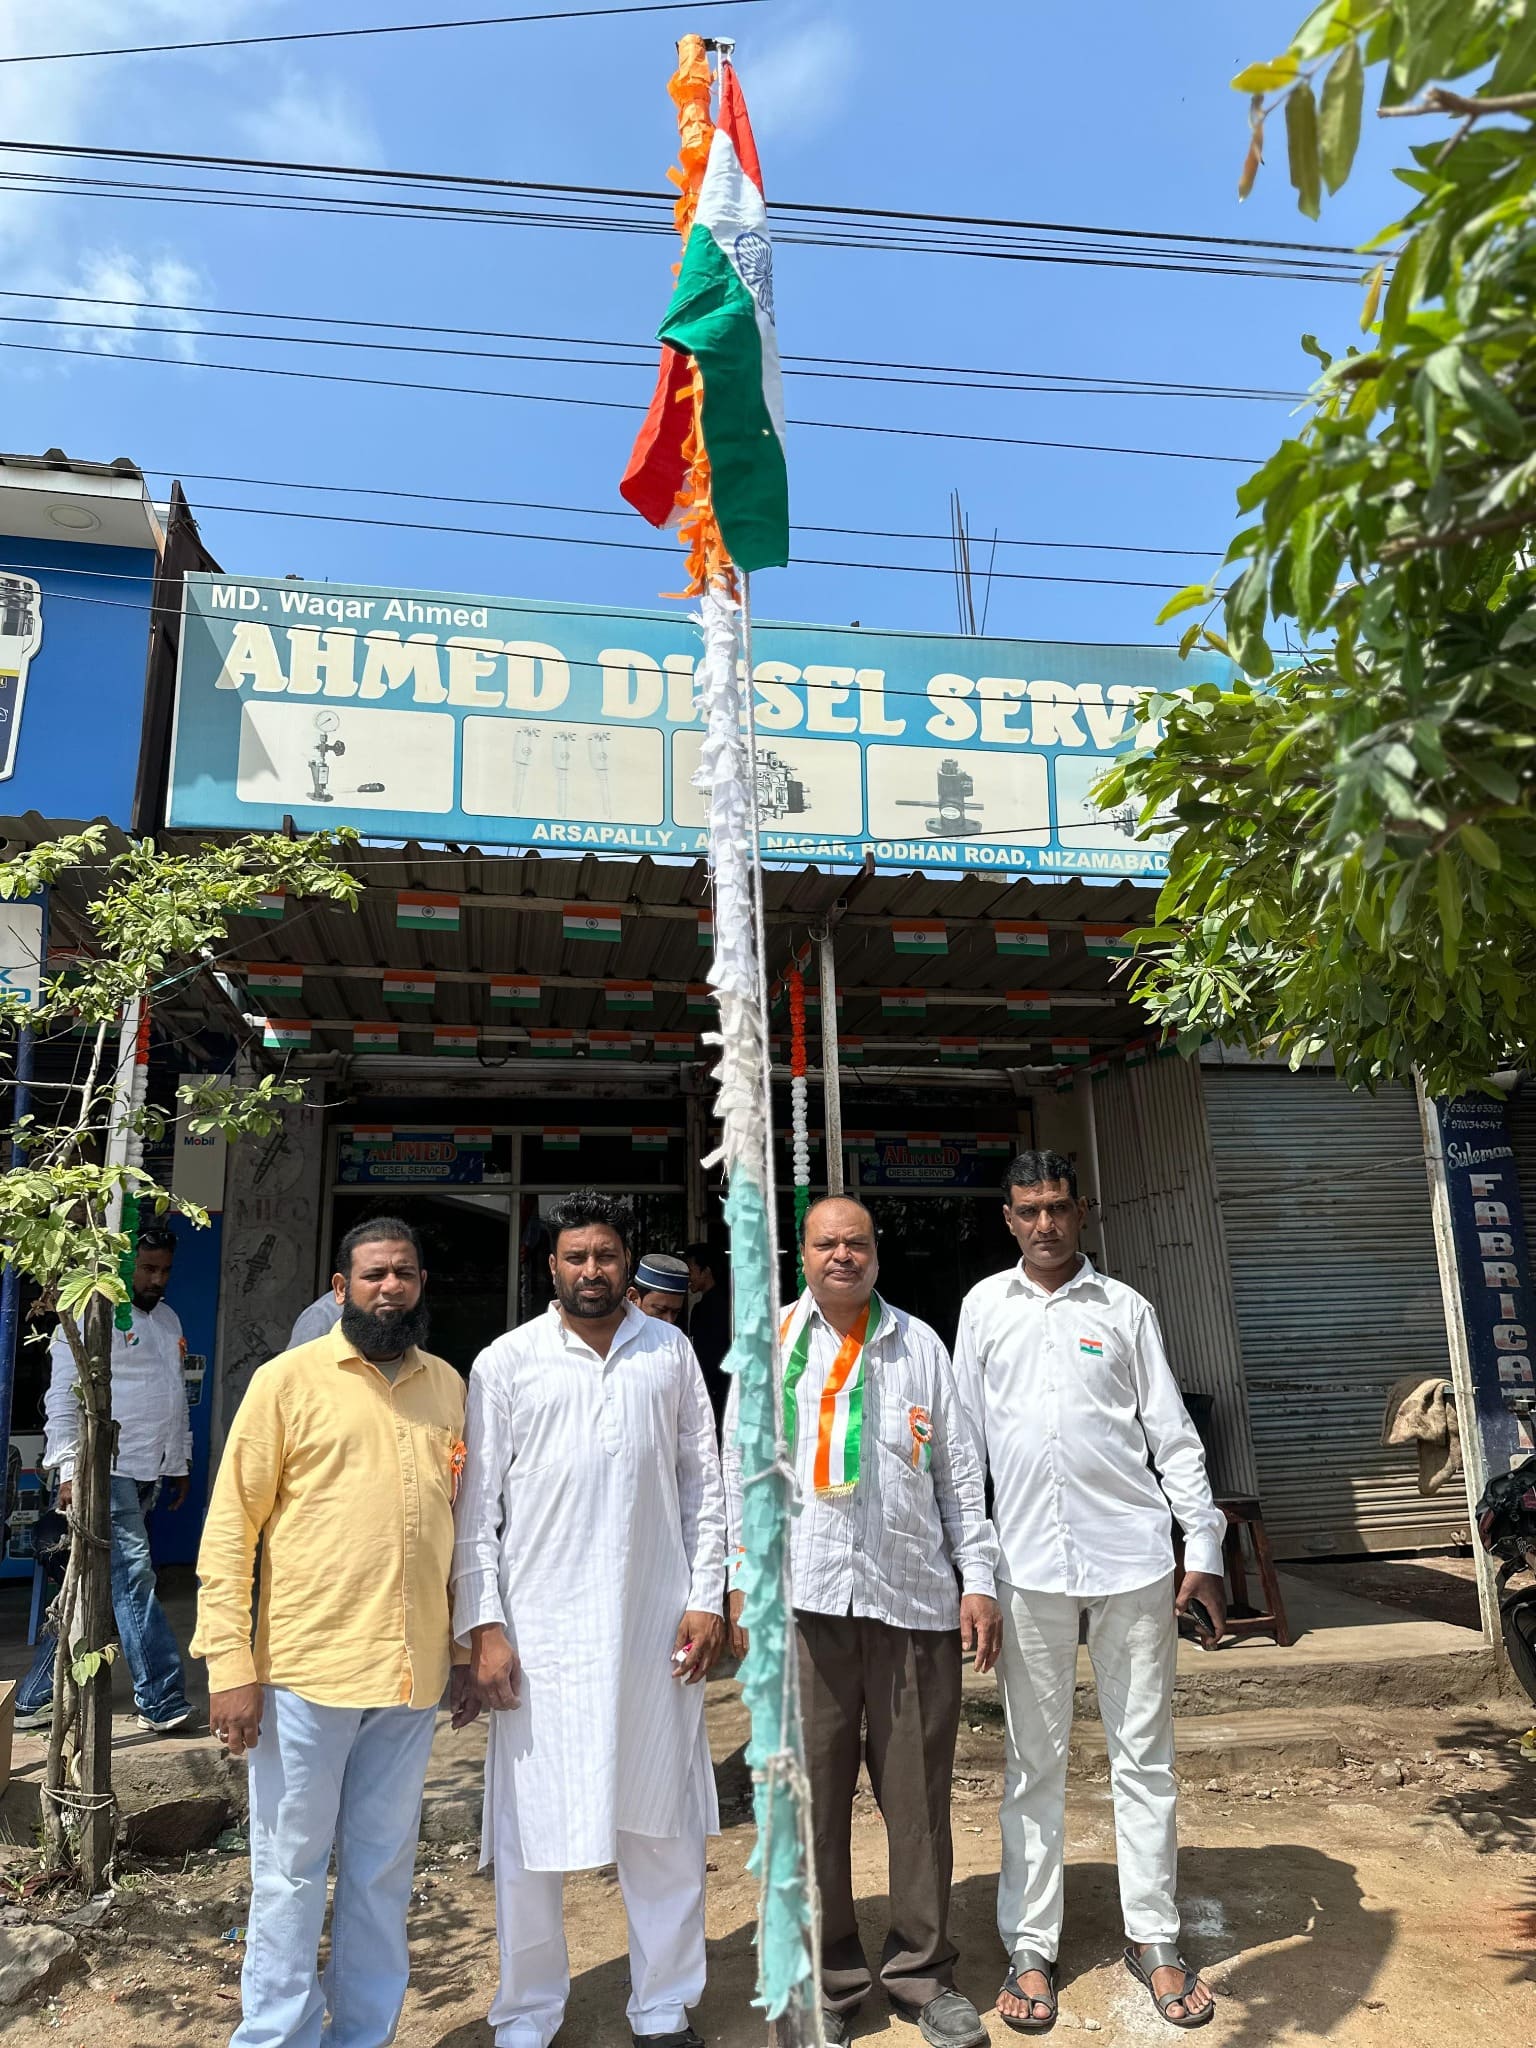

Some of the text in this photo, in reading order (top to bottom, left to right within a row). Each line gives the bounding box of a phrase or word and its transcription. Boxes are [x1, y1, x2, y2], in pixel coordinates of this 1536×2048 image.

[211, 585, 489, 629] MD. Waqar Ahmed
[214, 620, 571, 712] AHMED
[532, 823, 672, 849] ARSAPALLY
[766, 836, 854, 859] NAGAR,
[963, 846, 1032, 870] ROAD,
[1038, 850, 1168, 872] NIZAMABAD
[184, 1136, 215, 1146] Mobil
[1447, 1142, 1514, 1169] Suleman
[372, 1165, 448, 1175] DIESEL SERVICE
[888, 1168, 953, 1177] DIESEL SERVICE
